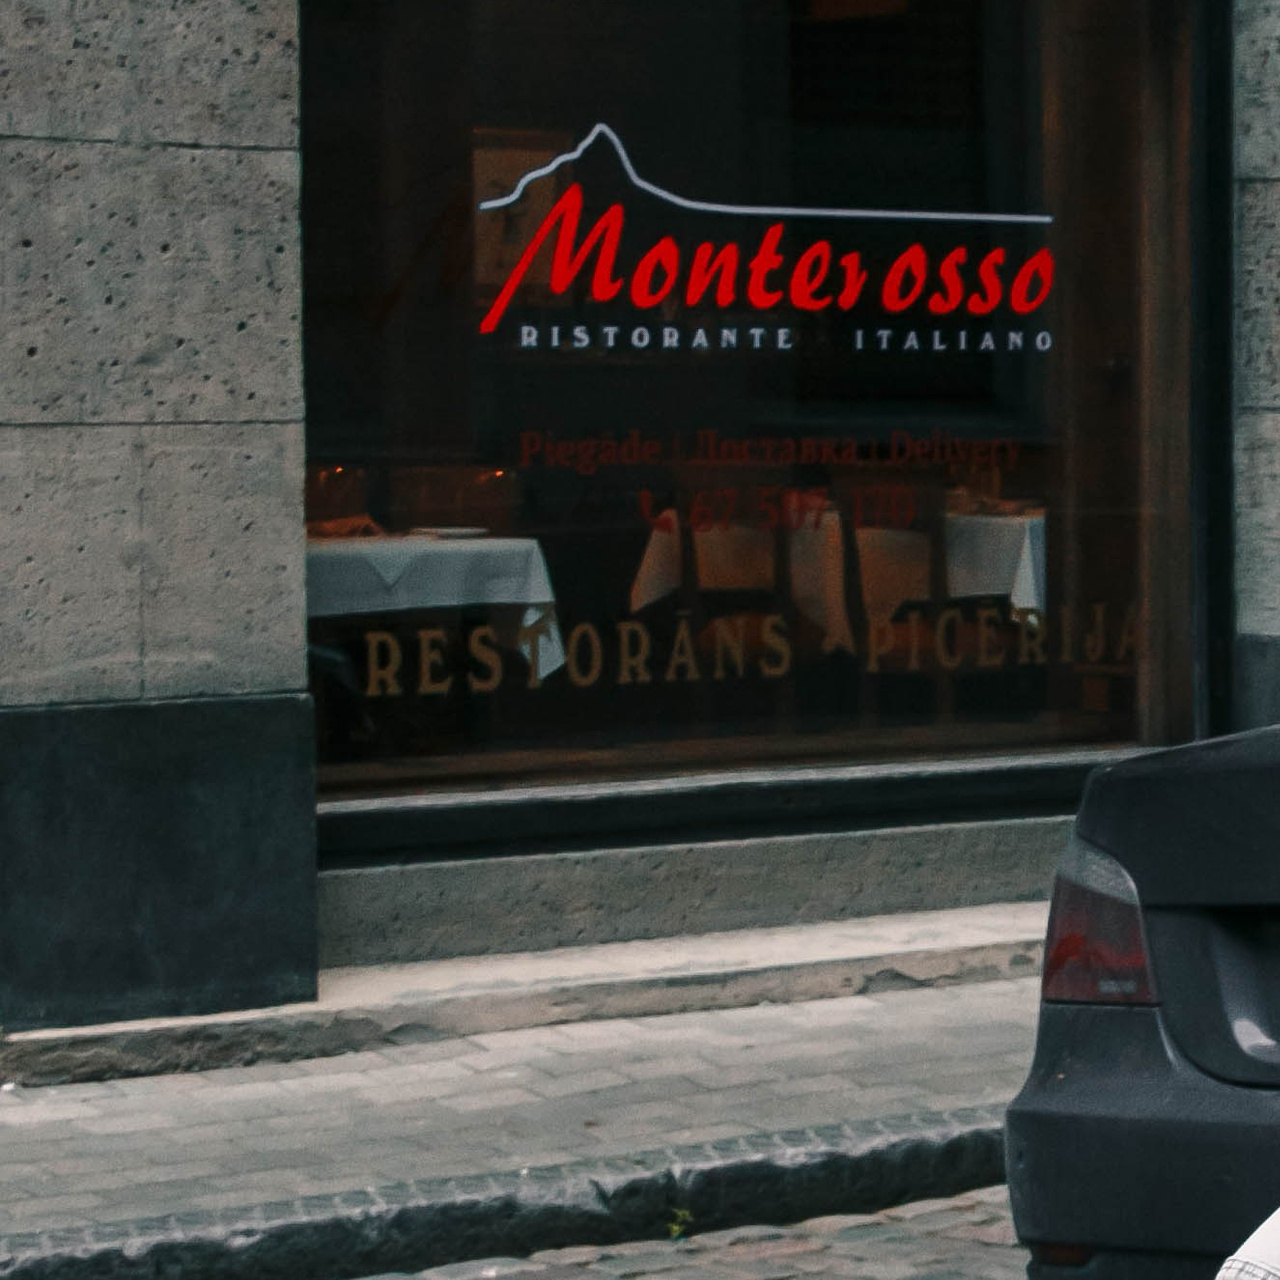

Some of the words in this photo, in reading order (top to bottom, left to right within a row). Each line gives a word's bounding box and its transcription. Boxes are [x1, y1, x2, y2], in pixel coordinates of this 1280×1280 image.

[479, 182, 1055, 334] Monterosso
[520, 325, 794, 350] RISTORANTE
[854, 328, 1054, 352] ITALIANO
[364, 608, 792, 698] RESTORĀNS
